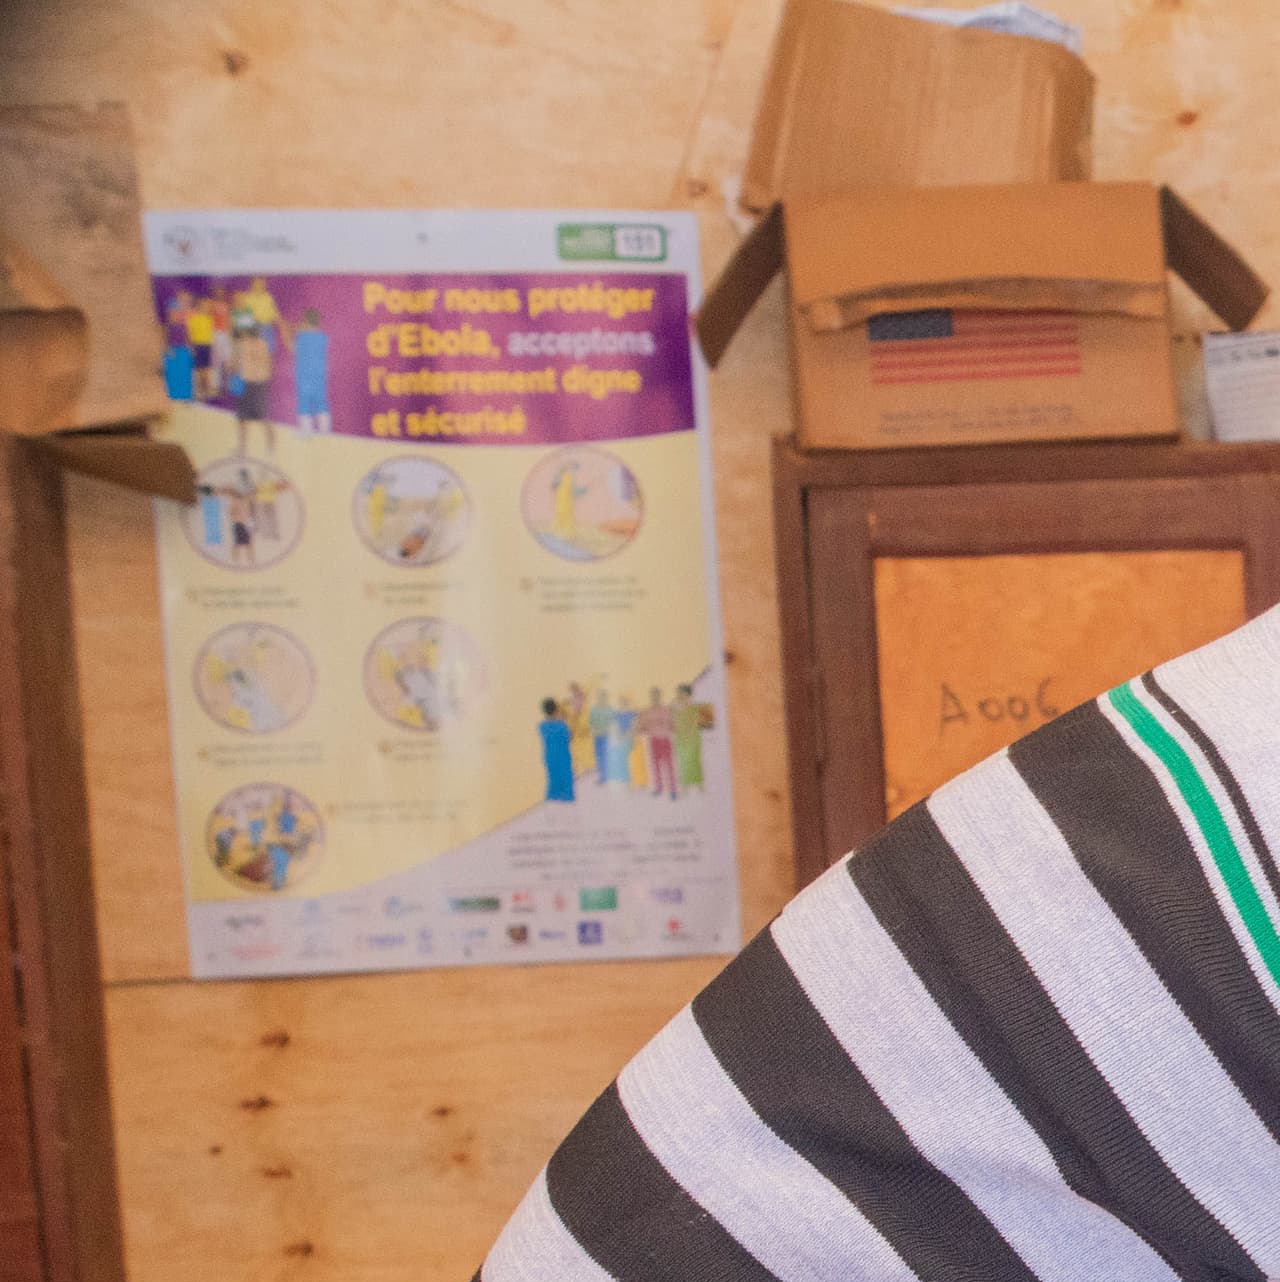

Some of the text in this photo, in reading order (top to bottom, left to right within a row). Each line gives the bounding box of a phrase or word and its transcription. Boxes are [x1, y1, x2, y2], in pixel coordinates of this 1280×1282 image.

[364, 282, 656, 319] Pour nous protéger
[507, 330, 656, 361] acceptons
[368, 366, 643, 400] l'enterrement digne
[371, 407, 527, 438] et sécurisé
